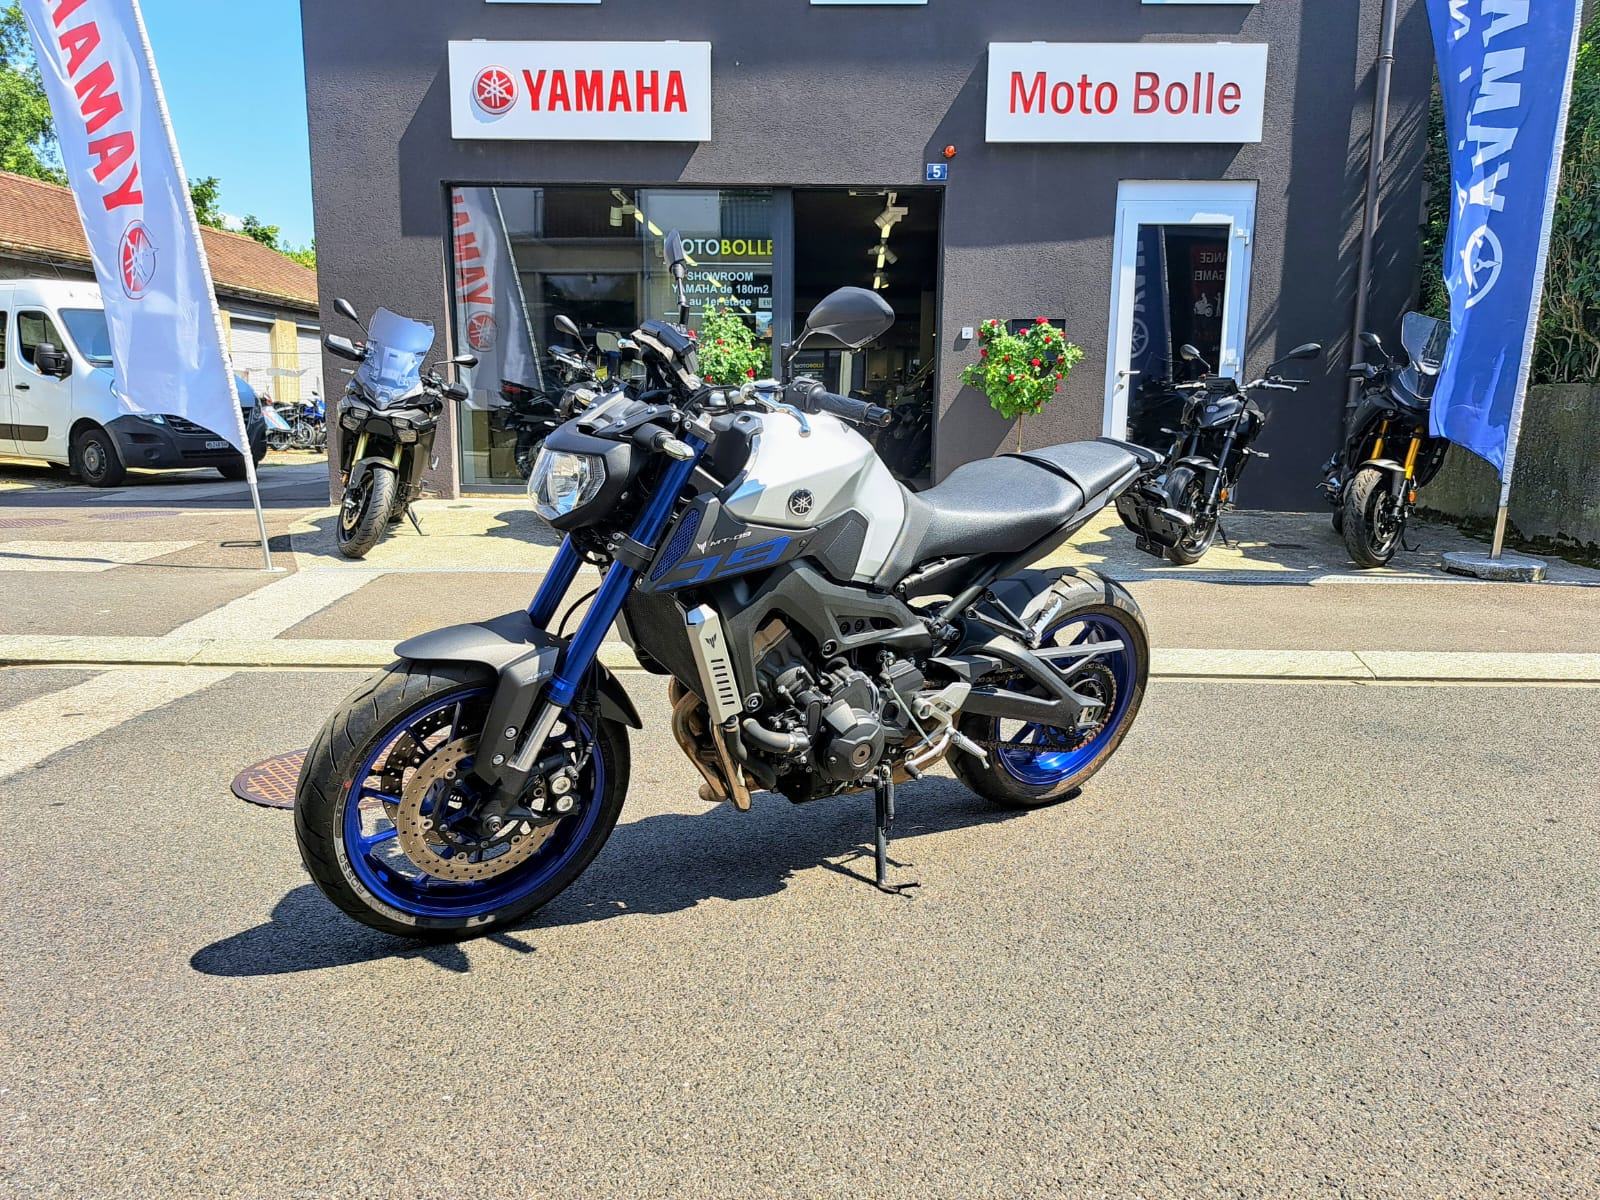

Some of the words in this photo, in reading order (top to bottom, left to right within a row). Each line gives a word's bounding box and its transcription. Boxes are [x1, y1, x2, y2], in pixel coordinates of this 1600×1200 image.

[522, 69, 688, 113] YAMAHA
[1009, 71, 1119, 115] Moto
[1133, 71, 1242, 116] Bolle
[932, 165, 942, 178] 5
[664, 239, 773, 256] OTOBOLLE
[687, 271, 753, 282] SHOWROOM
[720, 284, 733, 294] de
[735, 284, 769, 294] 180m2
[689, 297, 701, 306] au
[710, 531, 752, 547] MT-09
[339, 853, 365, 895] ROSSO
